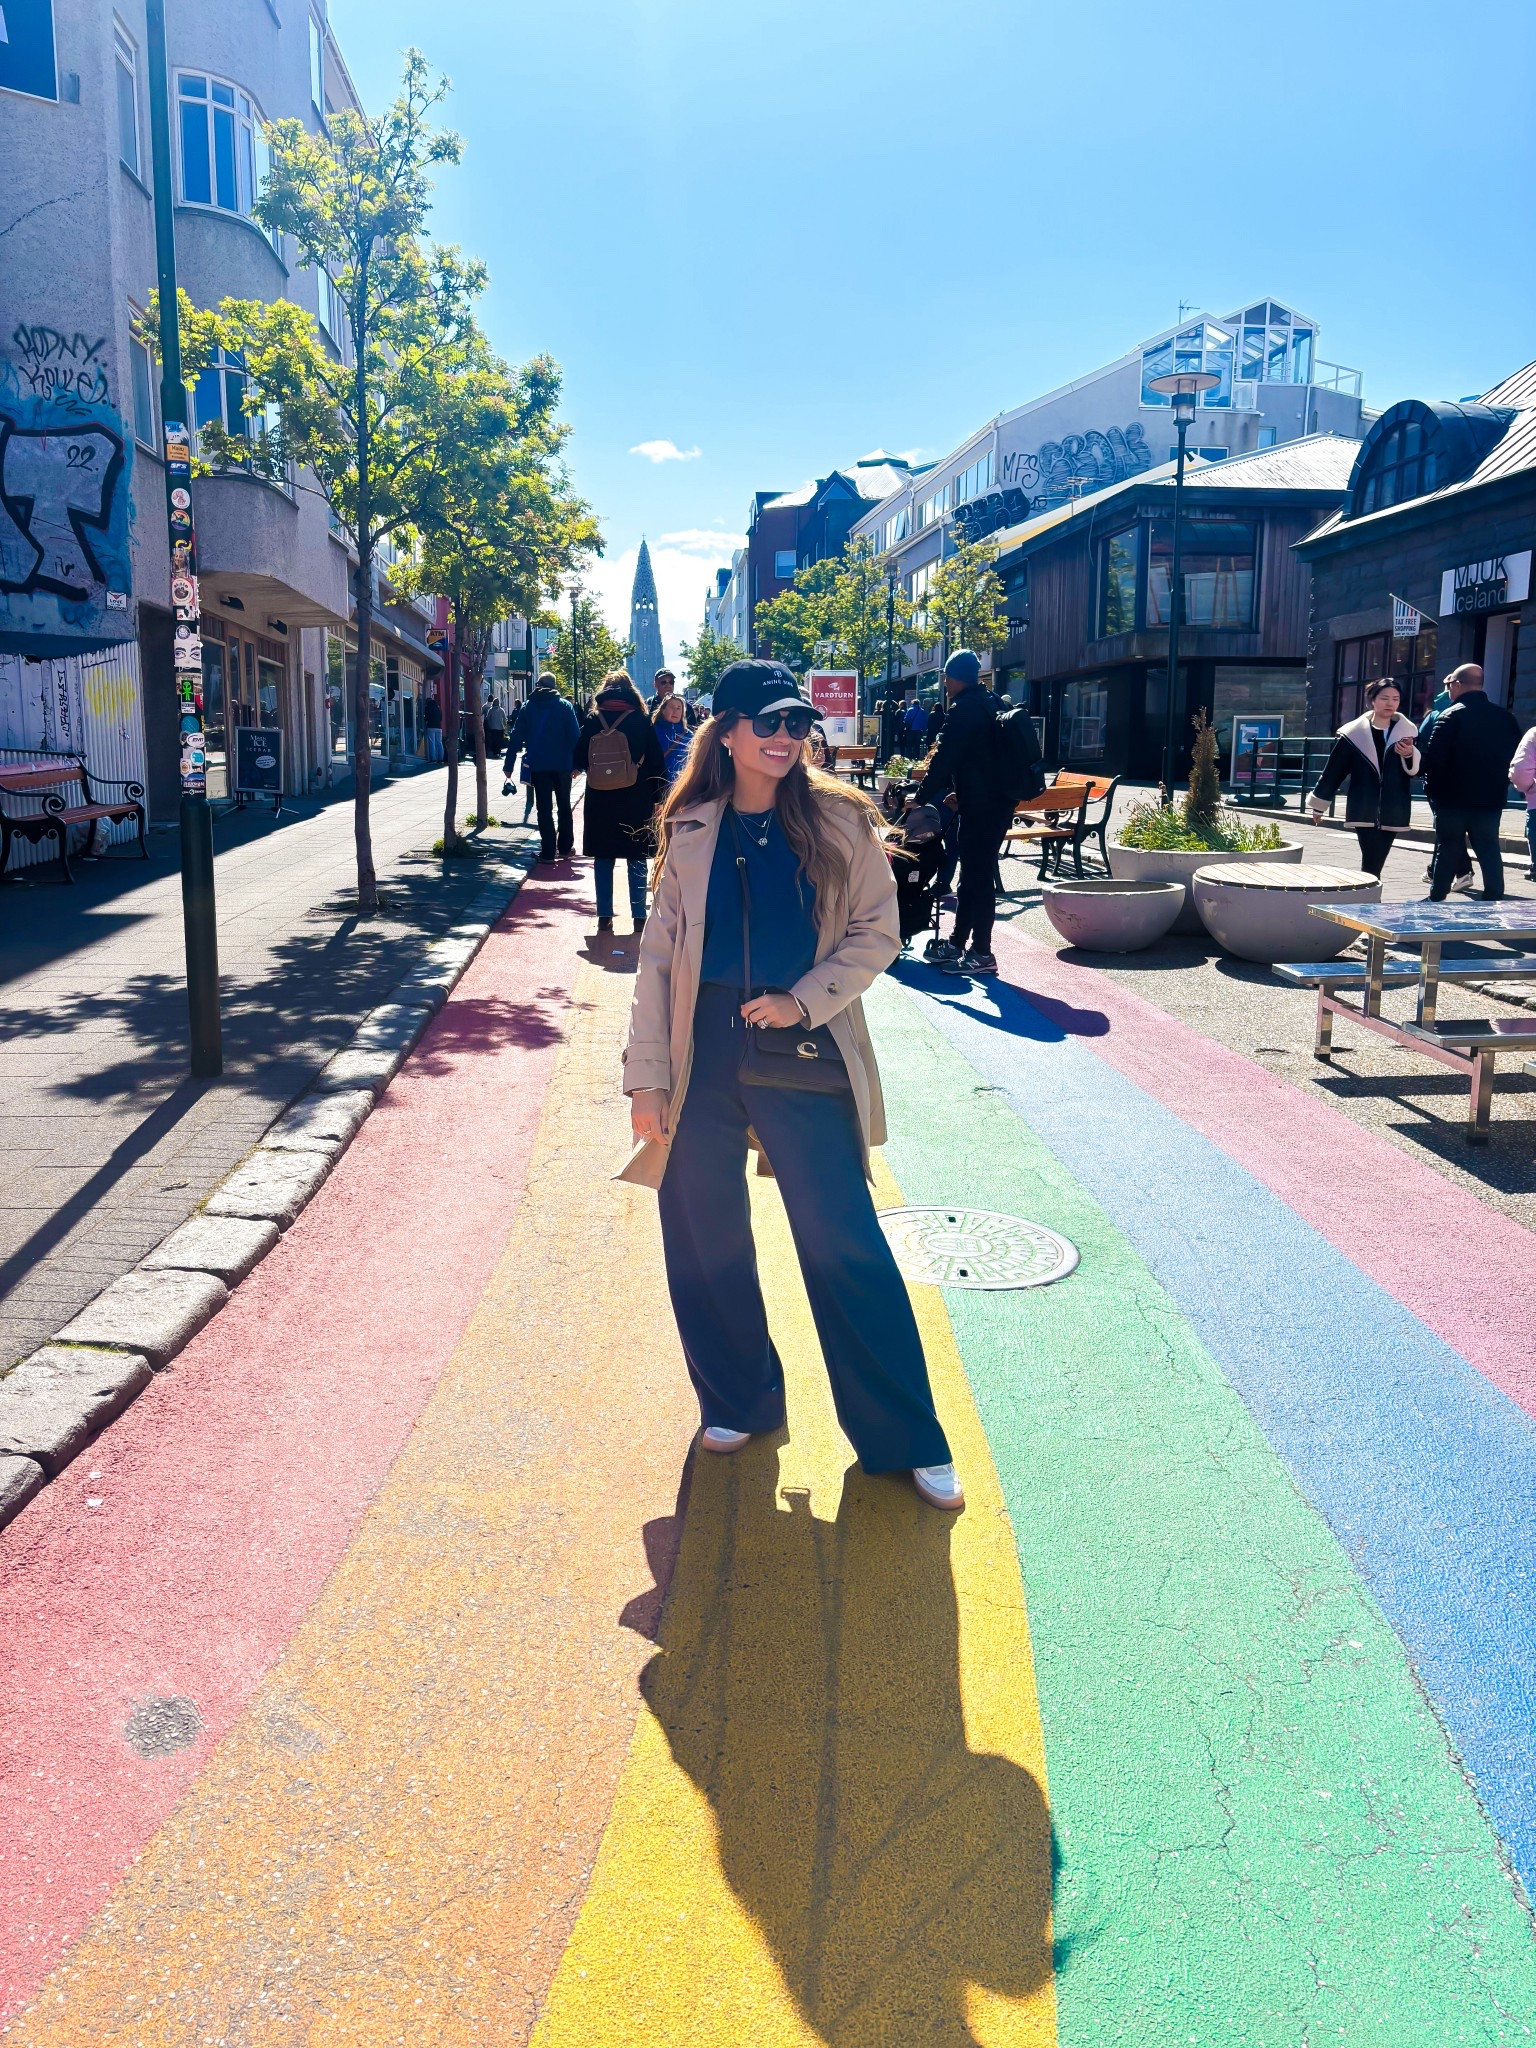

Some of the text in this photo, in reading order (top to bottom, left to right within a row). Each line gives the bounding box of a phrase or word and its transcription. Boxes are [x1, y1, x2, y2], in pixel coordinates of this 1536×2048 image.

[1003, 451, 1040, 489] MFS
[1454, 556, 1508, 590] MJUK
[1452, 580, 1508, 614] Iceland
[1395, 618, 1417, 626] TAX FREE
[762, 678, 782, 687] ANINE
